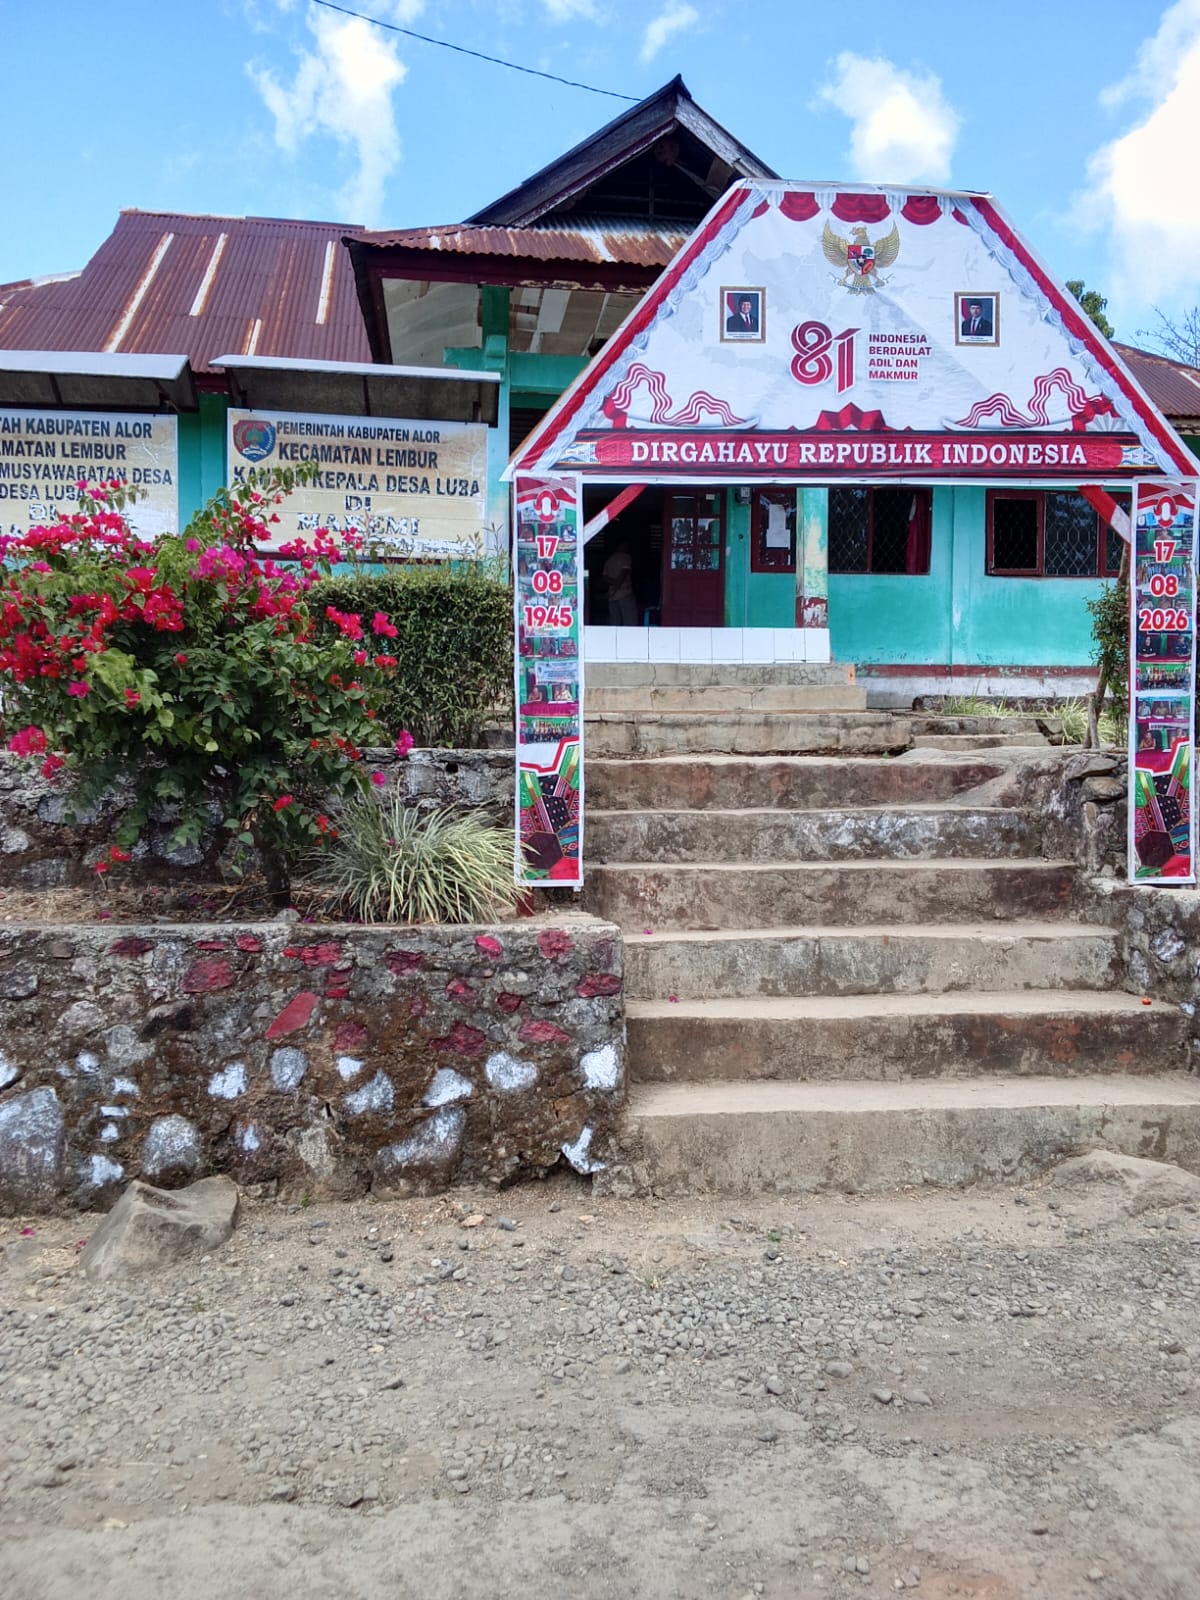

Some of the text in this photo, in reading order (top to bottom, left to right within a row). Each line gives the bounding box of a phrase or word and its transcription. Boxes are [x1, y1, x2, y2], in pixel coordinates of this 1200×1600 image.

[869, 334, 927, 343] INDONESIA
[791, 321, 862, 393] 81
[869, 346, 932, 356] BERDAULAT
[869, 358, 918, 368] ADIL DAN
[869, 370, 918, 380] MAKMUR
[0, 417, 152, 438] AH KABUPATEN ALOR
[276, 421, 441, 444] PEMERINTAH KABUPATEN ALOR
[61, 442, 127, 460] LEMBUR
[279, 443, 438, 469] KECAMATAN LEMBUR
[631, 441, 1087, 466] DIRGAHAYU REPUBLIK INDONESIA
[132, 468, 173, 485] DESA
[312, 471, 379, 492] KEPALA
[386, 475, 431, 495] DESA
[436, 478, 480, 497] LUBA
[0, 484, 86, 501] DESA LUBA
[345, 495, 371, 512] DI
[536, 536, 559, 558] 17
[1154, 541, 1176, 563] 17
[532, 570, 563, 593] 08
[1150, 574, 1179, 597] 08
[524, 606, 573, 628] 1945
[1139, 609, 1188, 631] 2026
